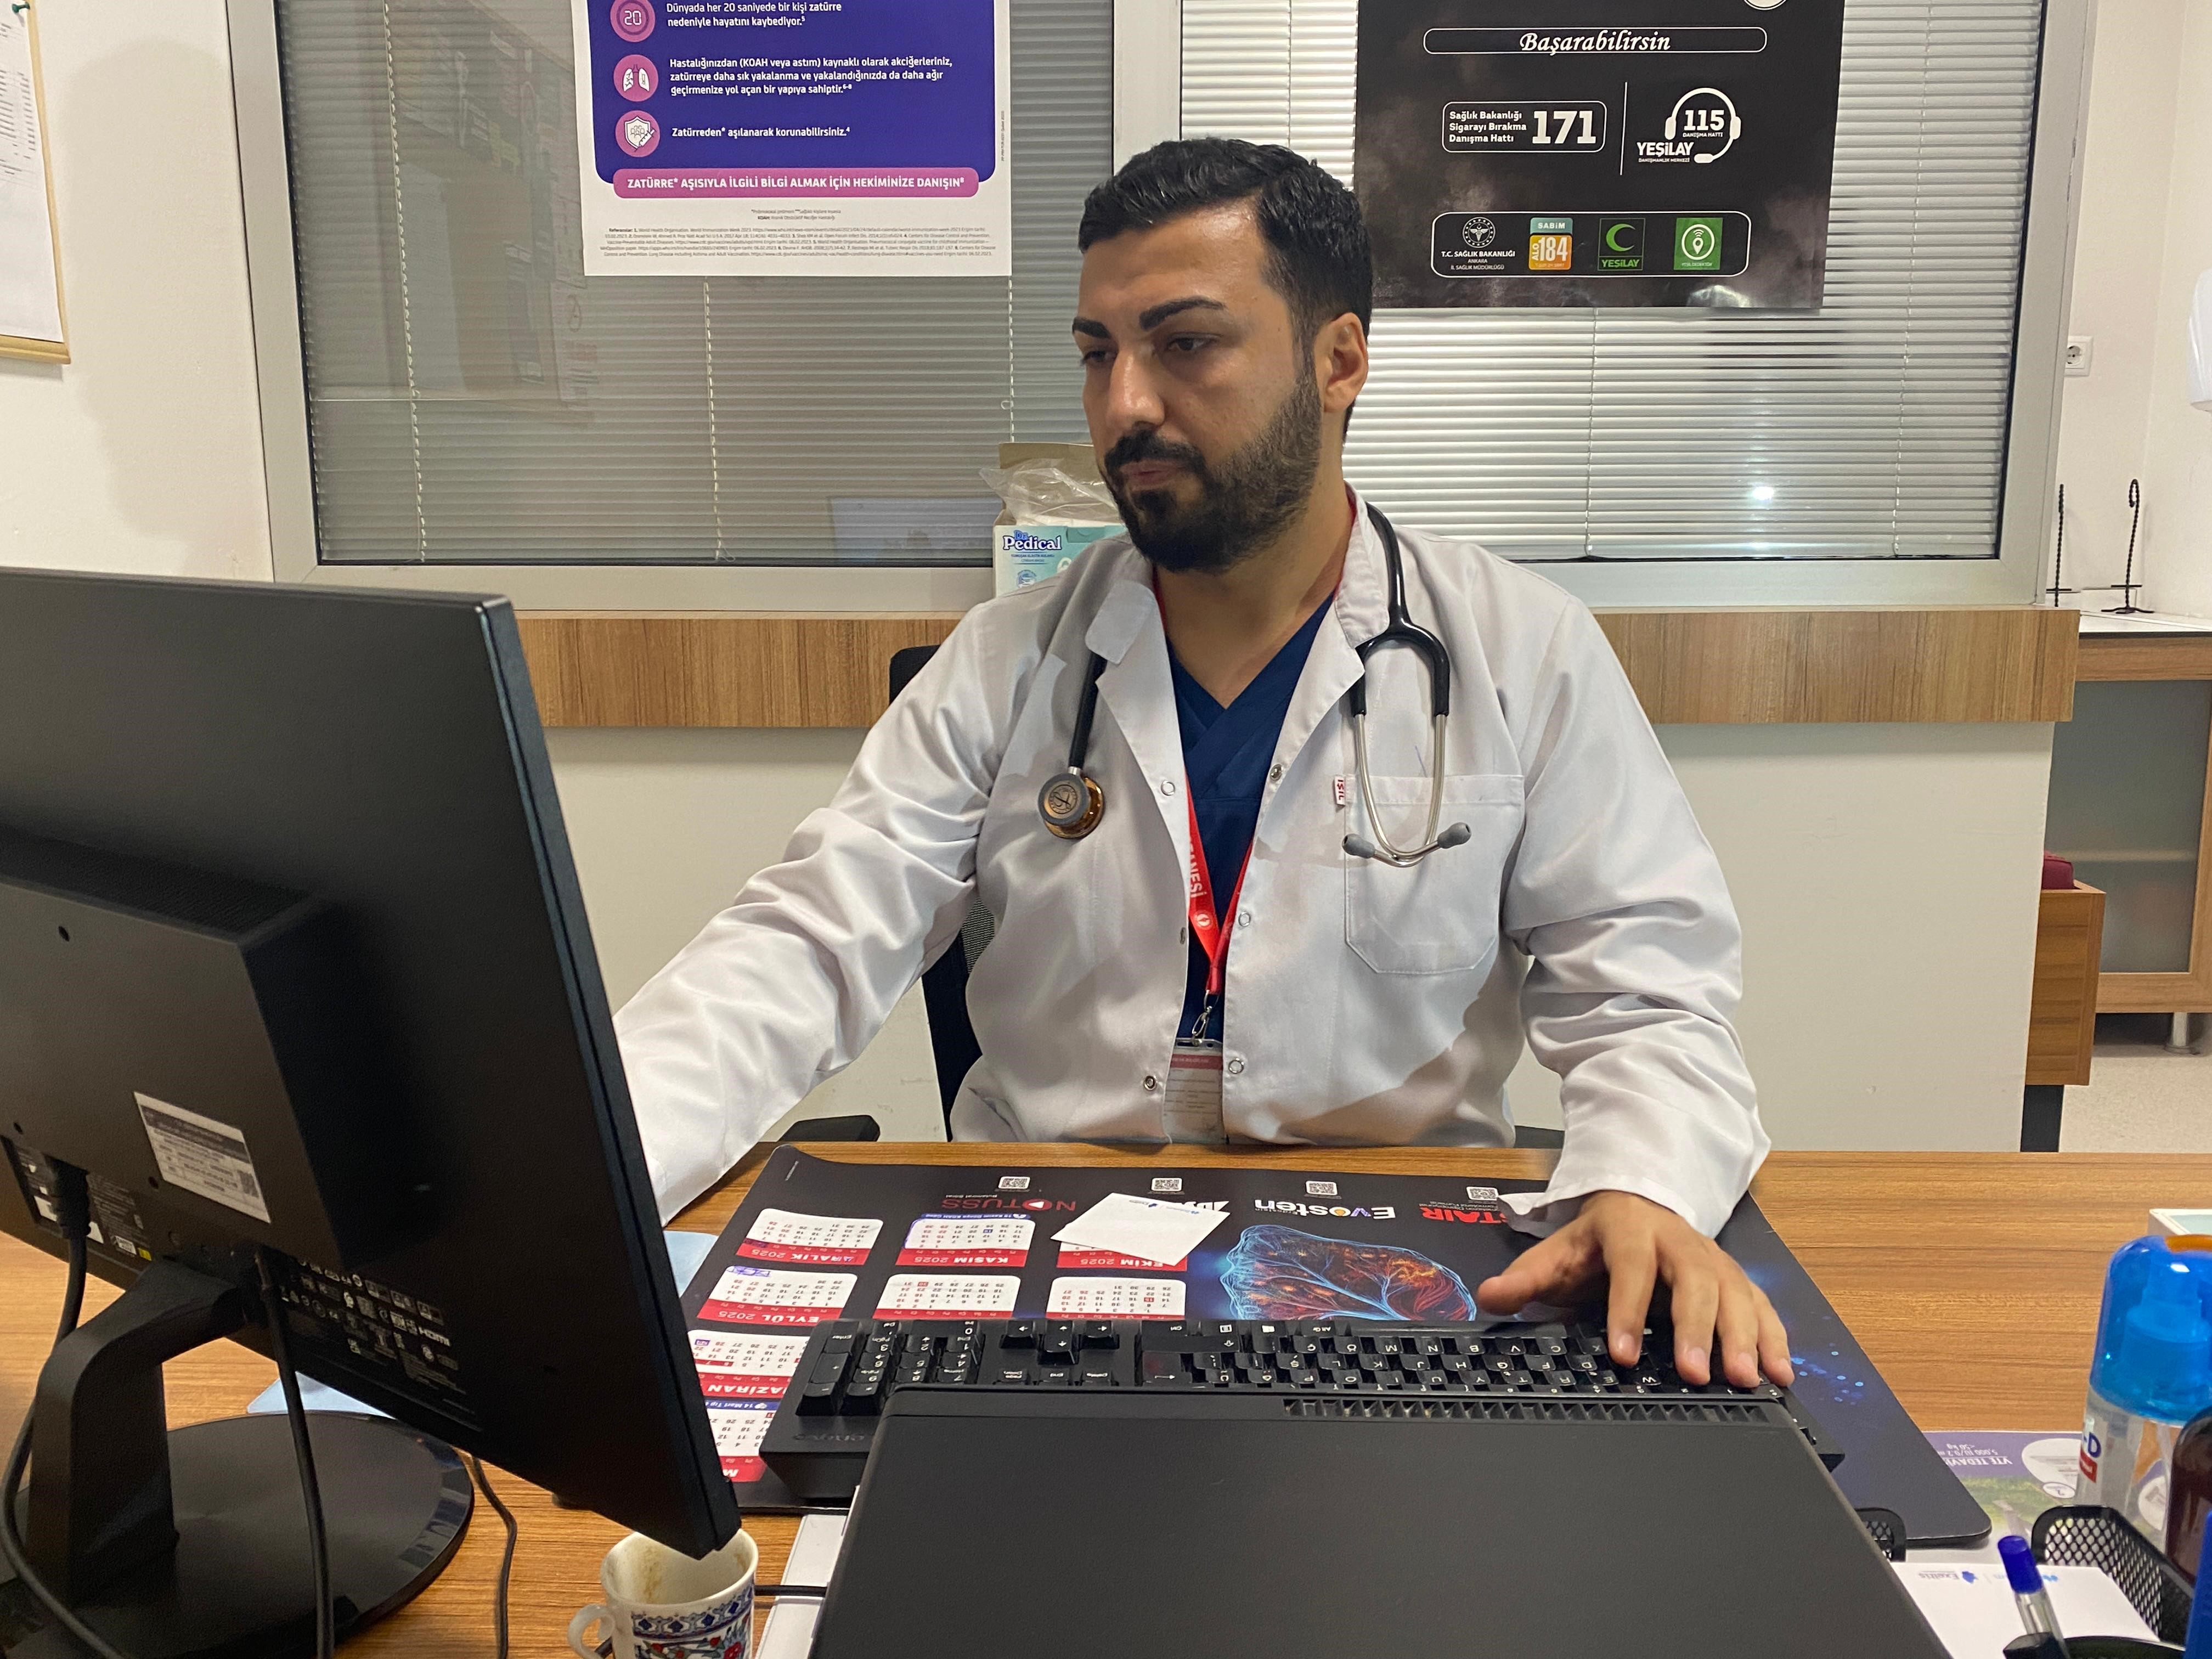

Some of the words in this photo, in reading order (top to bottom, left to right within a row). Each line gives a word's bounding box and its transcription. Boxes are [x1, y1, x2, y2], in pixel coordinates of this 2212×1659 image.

[667, 3, 705, 14] Dünyada
[707, 3, 721, 12] her
[724, 3, 735, 12] 20
[737, 2, 776, 13] saniyede
[778, 2, 790, 11] bir
[792, 2, 807, 14] kişi
[809, 2, 842, 11] zatürre
[624, 10, 641, 25] 20
[668, 17, 711, 28] nedeniyle
[713, 17, 749, 28] hayatını
[1520, 30, 1671, 56] Başarabilirsin
[670, 58, 737, 69] Hastalığınızdan
[740, 58, 768, 68] (KOAH
[770, 60, 791, 69] veya
[792, 58, 821, 67] astım)
[823, 58, 859, 68] kaynaklı
[861, 57, 889, 66] olarak
[891, 56, 952, 68] akciğerleriniz,
[670, 72, 711, 82] zatürreye
[713, 72, 735, 81] daha
[737, 72, 749, 81] sık
[751, 71, 799, 82] yakalanma
[813, 70, 887, 82] yakalandığınızda
[889, 70, 900, 79] da
[902, 70, 924, 79] daha
[926, 69, 943, 81] ağır
[671, 85, 723, 97] geçirmenize
[725, 85, 738, 95] yol
[741, 87, 761, 96] açan
[763, 84, 776, 93] bir
[777, 86, 806, 95] yapıya
[1449, 111, 1478, 121] Sağlık
[1480, 110, 1522, 121] Bakanlığı
[1684, 110, 1725, 131] 115
[727, 128, 774, 139] aşılanarak
[1449, 122, 1487, 133] Sigarayı
[1488, 122, 1527, 131] Bırakma
[1532, 110, 1596, 144] 171
[1449, 134, 1488, 144] Danışma
[1490, 134, 1514, 143] Hattı
[681, 178, 727, 190] AŞISIYLA
[729, 176, 758, 188] İLGİLİ
[760, 176, 788, 188] BİLGİ
[790, 177, 827, 187] ALMAK
[829, 176, 850, 190] İÇİN
[853, 176, 915, 188] HEKİMİNİZE
[1538, 236, 1568, 262] 184
[1003, 535, 1062, 550] Pedical
[1255, 1200, 1396, 1219] Evosten
[751, 1249, 786, 1259] 2025
[1120, 1259, 1163, 1267] EKİM
[718, 1311, 755, 1319] 2025
[761, 1314, 820, 1323] EYLÜL
